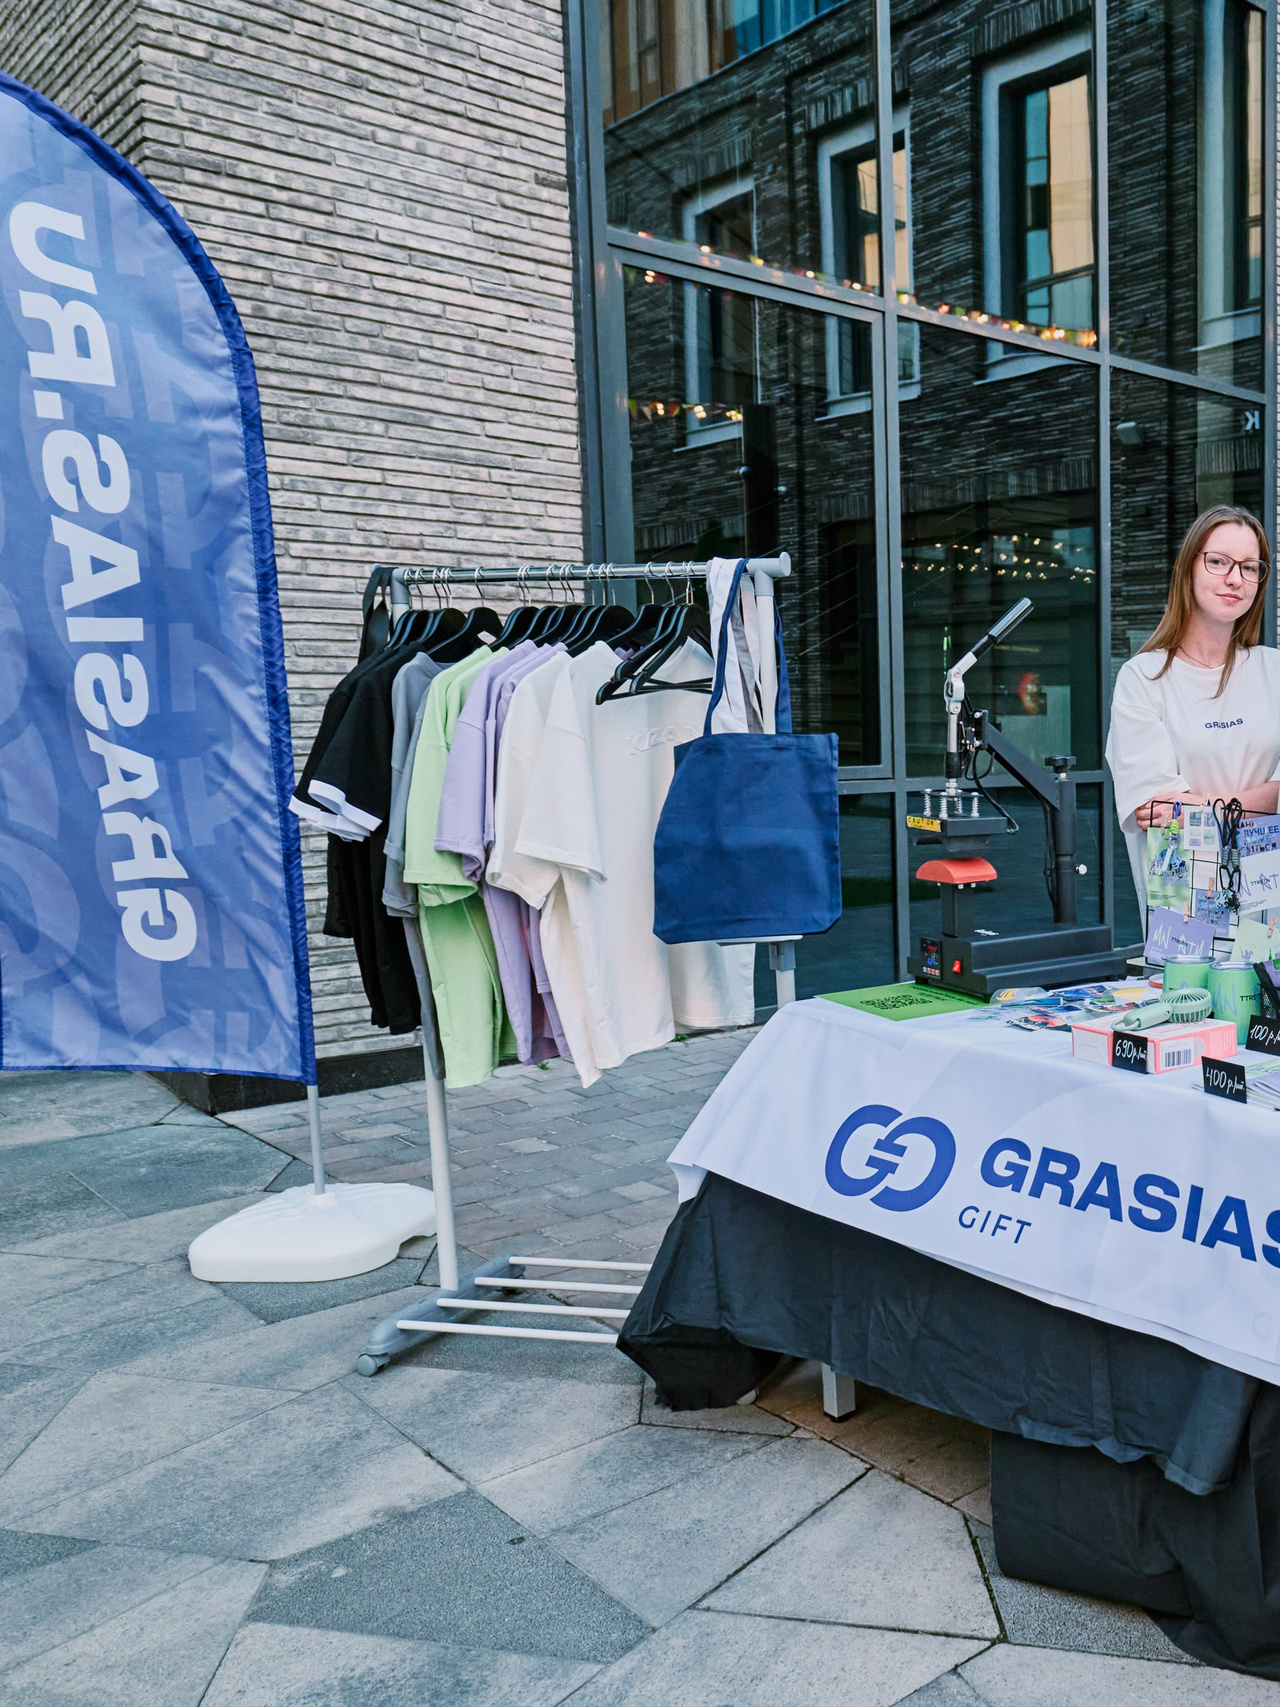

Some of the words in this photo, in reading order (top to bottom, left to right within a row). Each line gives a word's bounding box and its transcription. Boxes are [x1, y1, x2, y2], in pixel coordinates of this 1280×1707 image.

[1205, 718, 1243, 729] GRASIAS
[1250, 1024, 1268, 1041] 100
[1206, 1066, 1227, 1088] 400
[957, 1205, 1032, 1244] GIFT
